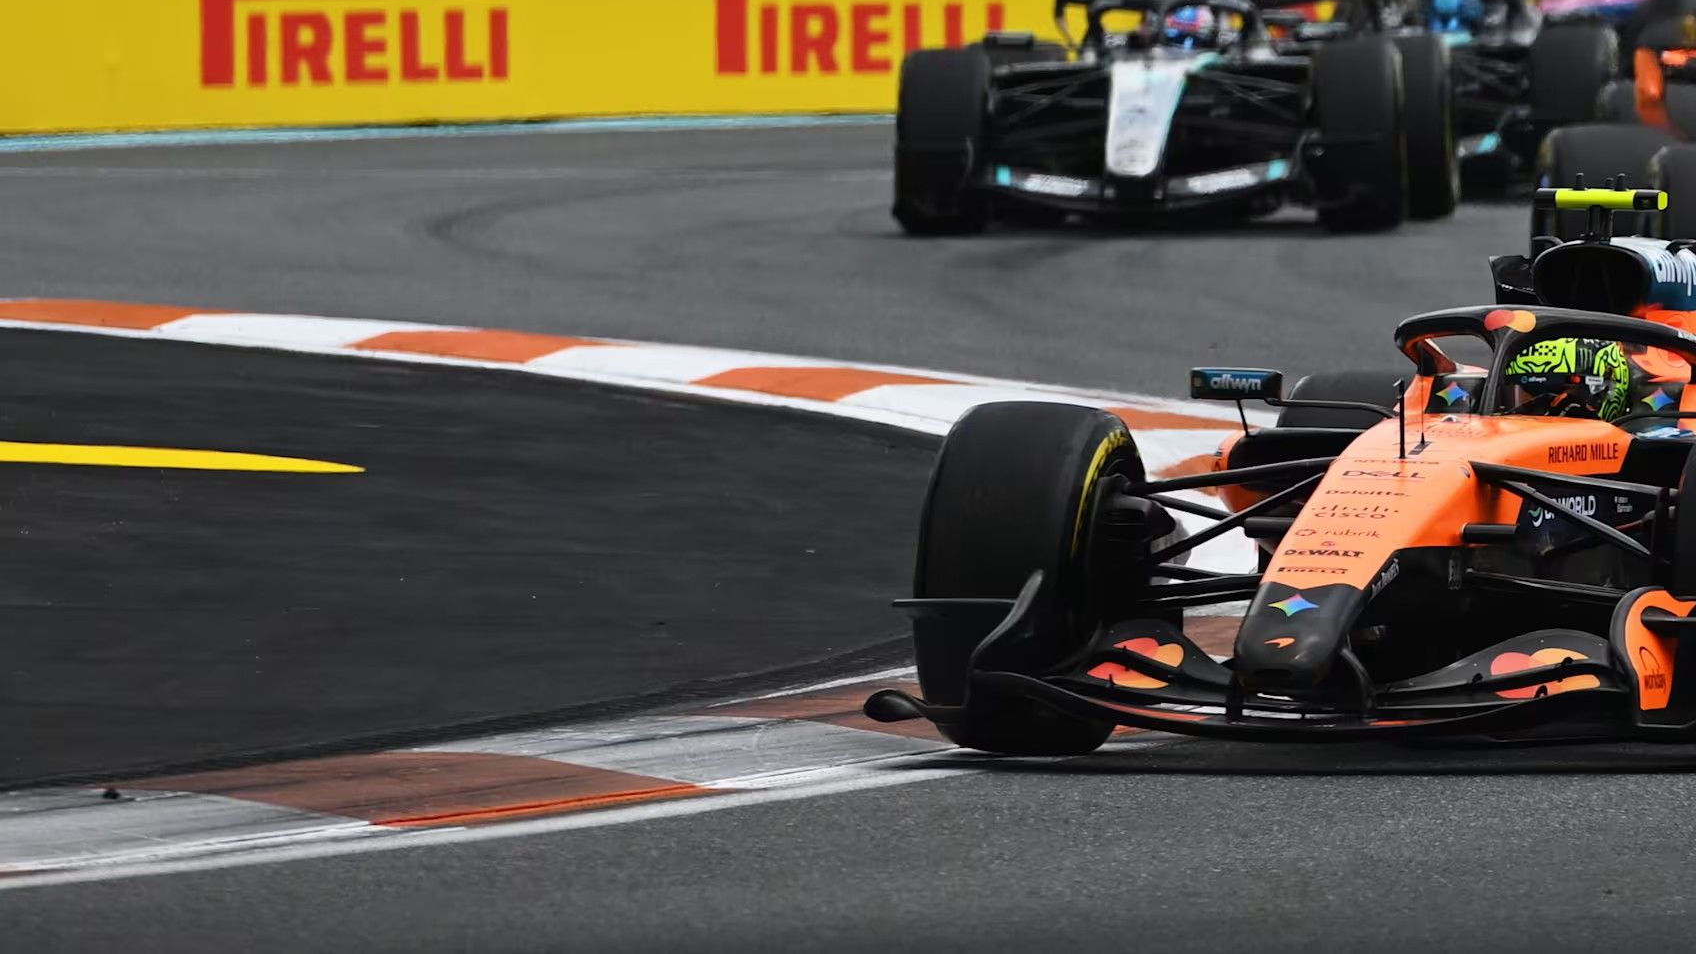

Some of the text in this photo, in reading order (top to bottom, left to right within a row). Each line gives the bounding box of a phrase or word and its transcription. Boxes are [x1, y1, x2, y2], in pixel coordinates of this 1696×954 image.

[1211, 374, 1261, 393] allwyn
[1548, 443, 1619, 464] RICHARD MILLE
[1342, 470, 1426, 479] DELL
[1325, 528, 1381, 539] rubrik
